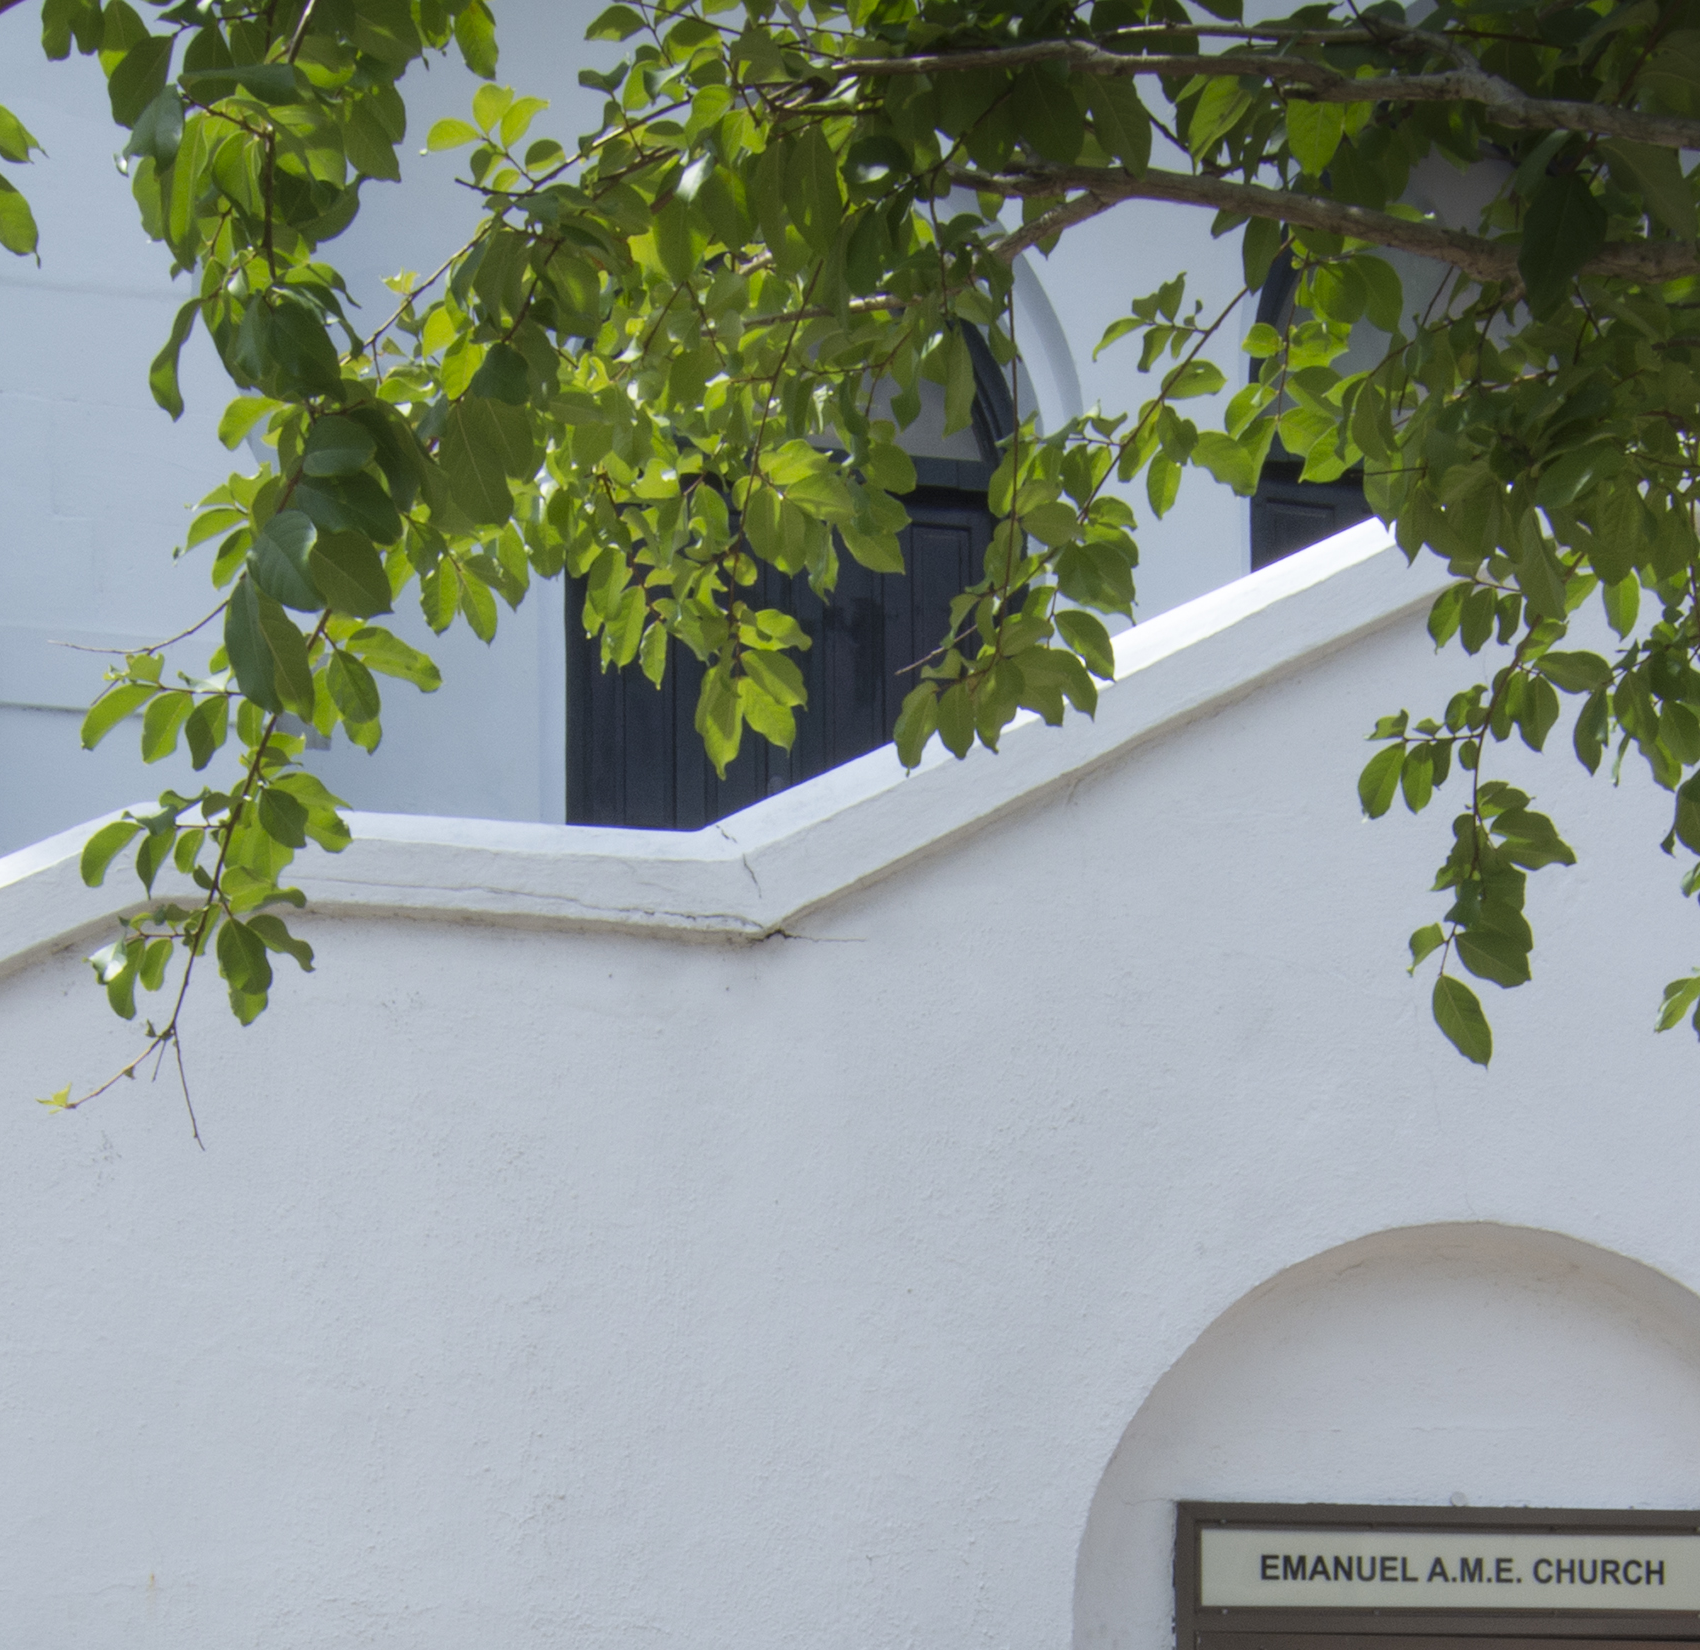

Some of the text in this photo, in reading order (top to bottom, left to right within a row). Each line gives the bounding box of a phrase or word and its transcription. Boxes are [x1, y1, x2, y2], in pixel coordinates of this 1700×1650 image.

[1260, 1554, 1666, 1586] EMANUEL A.M.E. CHURCH
